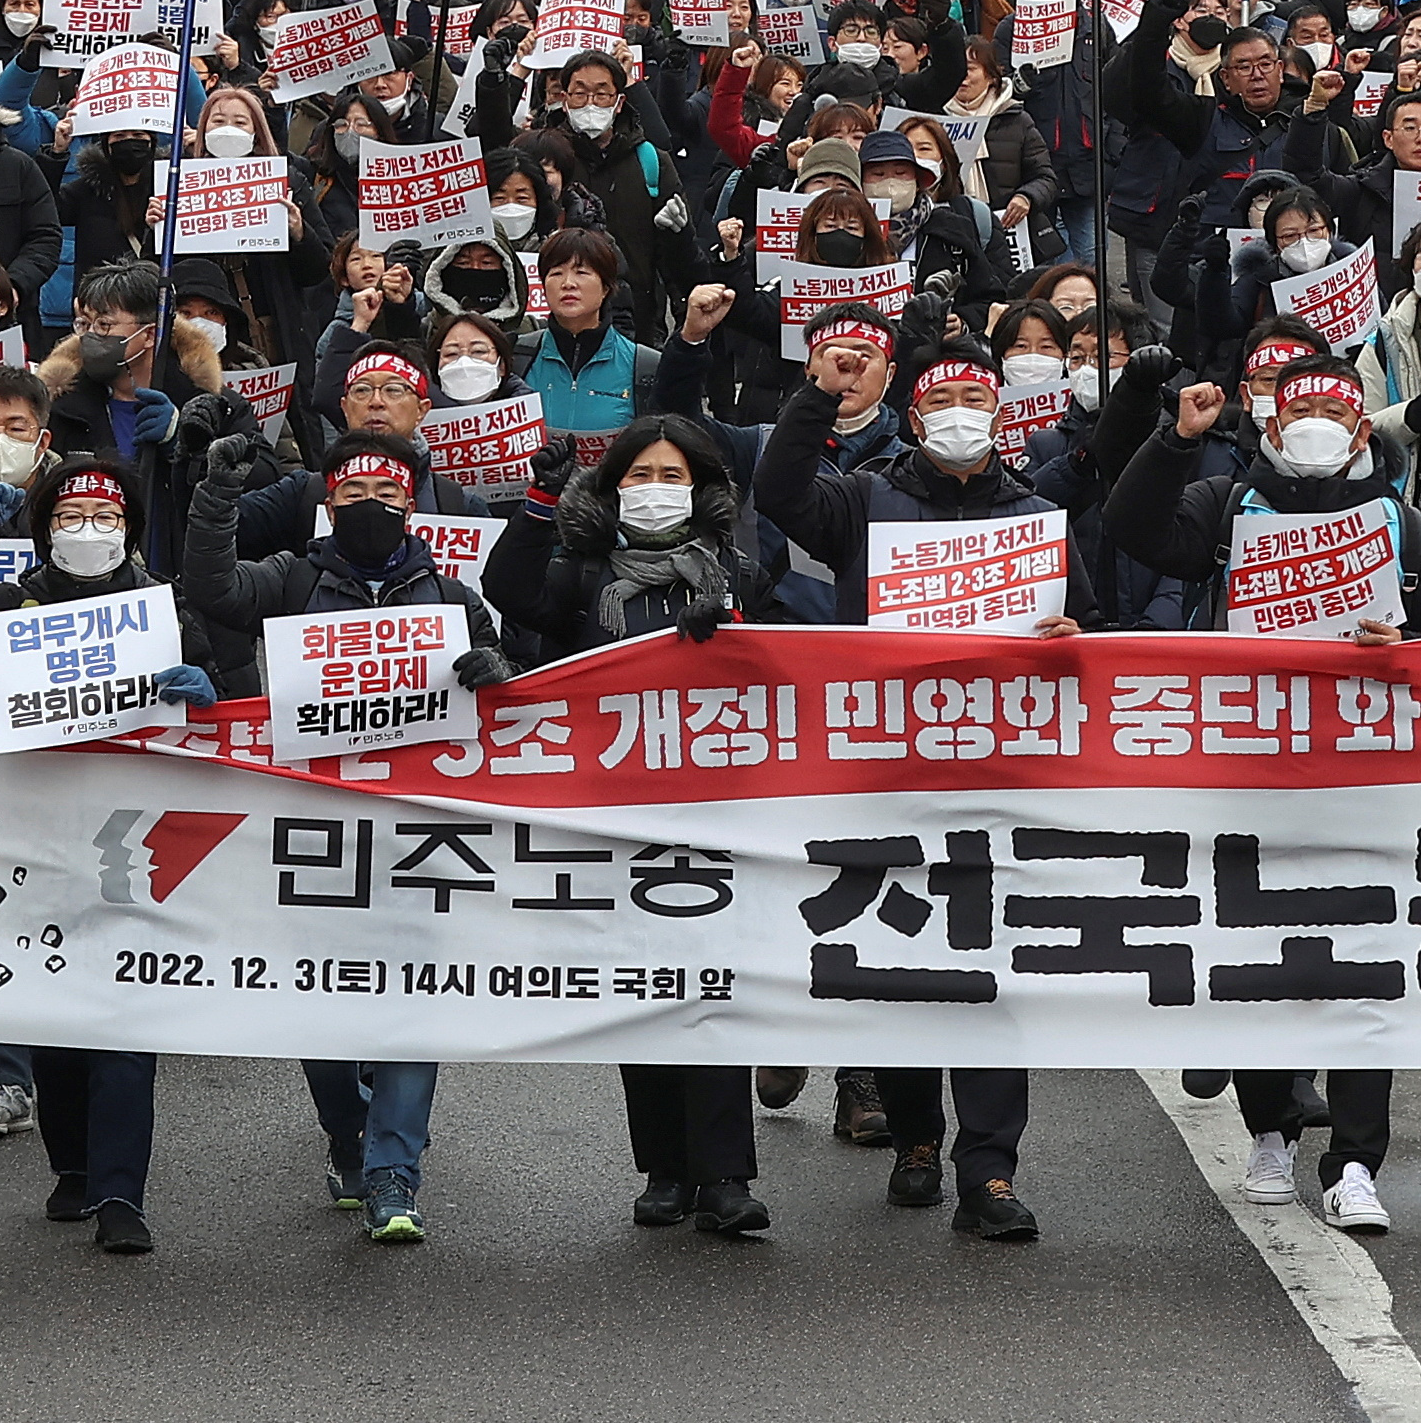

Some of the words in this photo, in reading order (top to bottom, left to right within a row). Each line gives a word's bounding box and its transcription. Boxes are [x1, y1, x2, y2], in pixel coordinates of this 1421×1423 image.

[68, 10, 131, 33] 운임제
[327, 6, 363, 31] 저지!
[143, 51, 172, 68] 저지!
[289, 58, 334, 83] 민영화
[337, 43, 371, 68] 중단!
[88, 95, 134, 117] 민영화
[136, 94, 170, 110] 중단!
[236, 161, 272, 185] 저지!
[366, 155, 417, 178] 노동개악
[419, 143, 464, 171] 저지!
[361, 184, 393, 206] 노조법
[440, 164, 481, 193] 개정!
[180, 214, 228, 237] 민영화
[231, 208, 268, 229] 중단!
[373, 208, 420, 233] 민영화
[423, 196, 467, 224] 중단!
[793, 278, 855, 297] 노동개악
[859, 268, 898, 291] 저지!
[1283, 374, 1312, 401] 단결
[485, 401, 528, 432] 저지!
[504, 425, 543, 456] 개정!
[891, 532, 988, 571] 노동개악
[993, 518, 1045, 553] 저지!
[1242, 529, 1308, 565] 노동개악
[1311, 512, 1366, 547] 저지!
[878, 571, 946, 608] 노조법
[1010, 547, 1059, 582] 개정!
[1234, 569, 1282, 604] 노조법
[1340, 535, 1388, 578] 개정!
[983, 587, 1037, 622] 중단!
[1254, 598, 1318, 634] 민영화
[1320, 578, 1376, 618] 중단!
[6, 600, 149, 653] 업무개시
[303, 616, 446, 660] 화물안전
[46, 647, 116, 684] 명령
[320, 654, 427, 698] 운임제
[7, 675, 160, 728] 철회하라!
[296, 690, 448, 738] 확대하라!
[78, 719, 118, 735] 민주노총
[363, 731, 405, 746] 민주노총
[598, 685, 796, 770] 개정!
[828, 676, 1088, 763] 민영화
[1109, 673, 1312, 758] 중단!
[273, 816, 735, 917] 민주노총
[115, 950, 215, 987] 2022.
[231, 956, 278, 990] 12.
[295, 957, 387, 996] 3(토)
[401, 961, 475, 998] 14시
[489, 964, 599, 1000] 여의도
[613, 967, 686, 1001] 국회
[699, 968, 735, 1002] 앞
